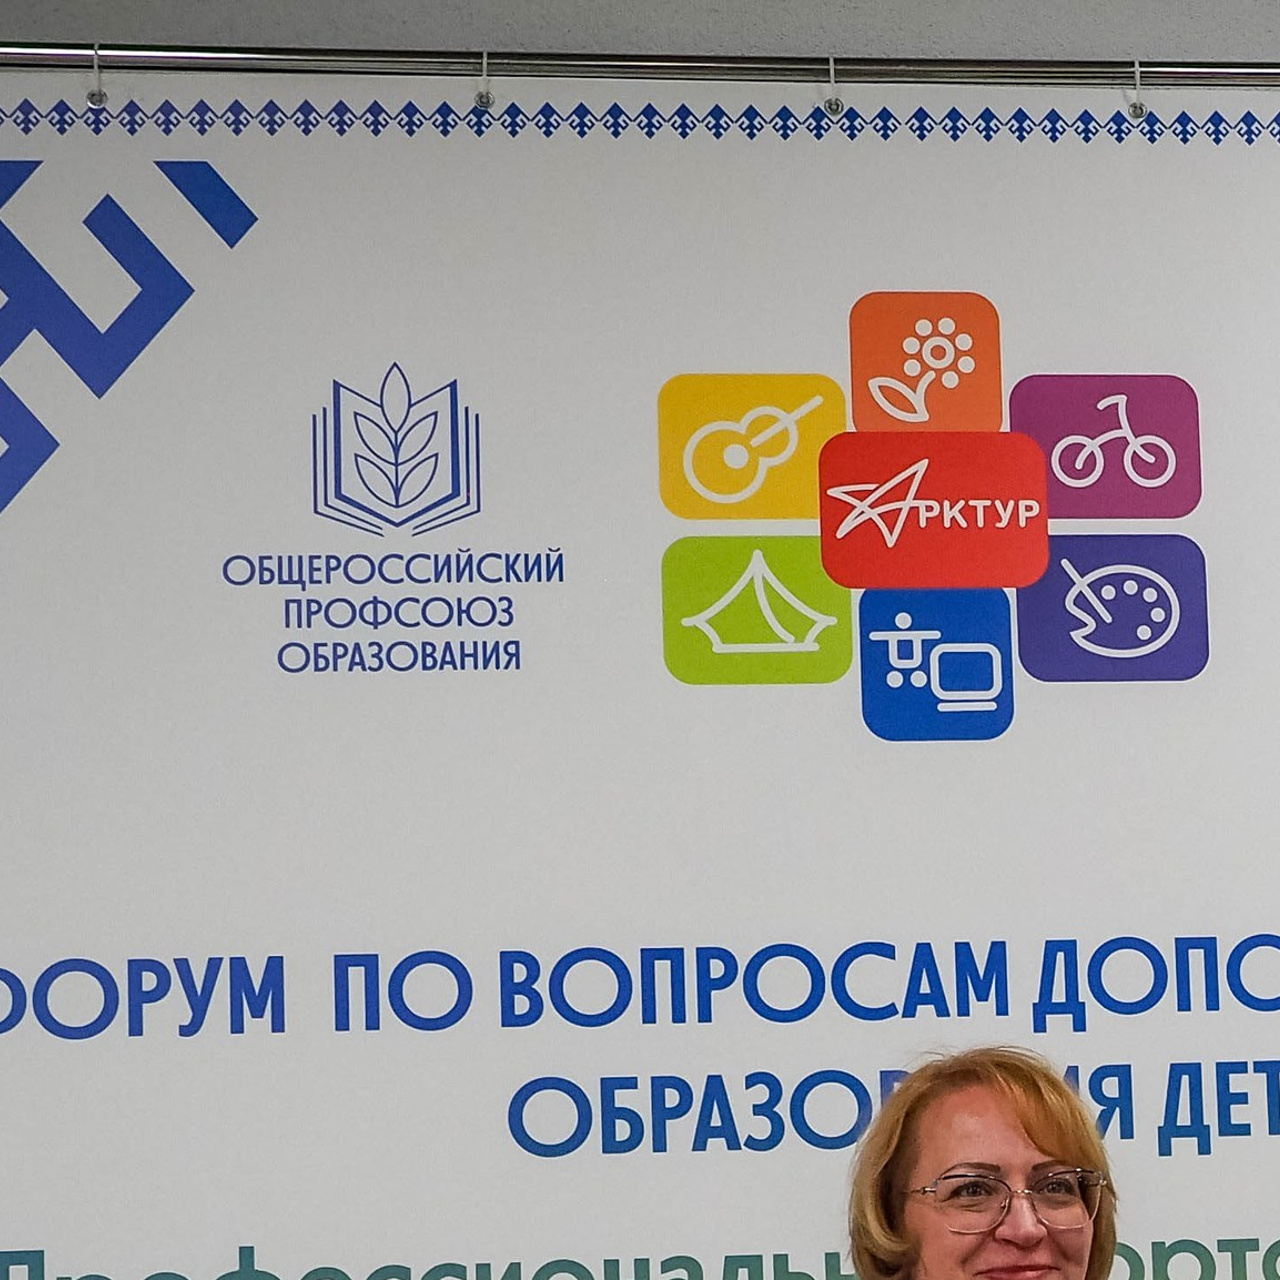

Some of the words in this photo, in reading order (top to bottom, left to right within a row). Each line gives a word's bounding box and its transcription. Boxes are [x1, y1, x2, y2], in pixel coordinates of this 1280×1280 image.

[222, 548, 565, 592] ОБЩЕРОССИЙСКИЙ
[284, 596, 514, 630] ПРОФСОЮЗ
[277, 640, 522, 674] ОБРАЗОВАНИЯ
[333, 951, 473, 1031] ПО
[499, 941, 1009, 1028] ВОПРОСАМ
